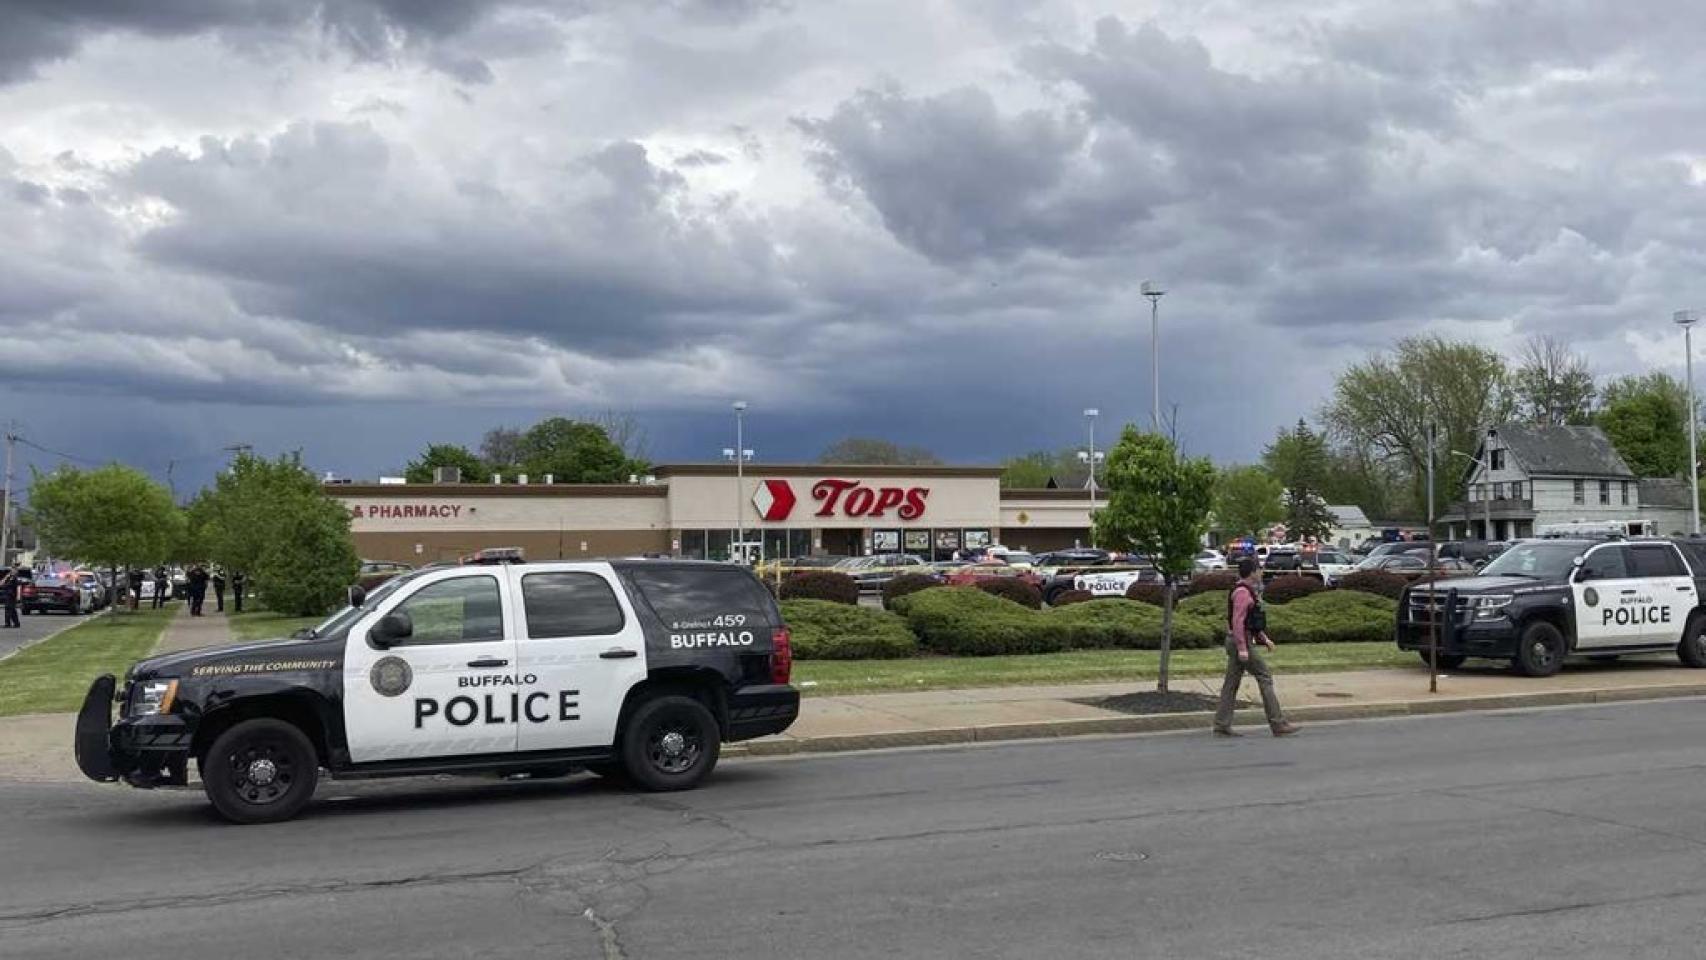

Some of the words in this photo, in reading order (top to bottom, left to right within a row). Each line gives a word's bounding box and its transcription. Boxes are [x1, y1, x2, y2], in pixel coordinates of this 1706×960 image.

[369, 505, 461, 518] PHARMACY
[713, 614, 746, 627] 459
[1602, 606, 1671, 626] POLICE
[670, 631, 754, 648] BUFFALO
[192, 664, 241, 676] SERVING
[243, 663, 265, 673] THE
[266, 660, 336, 671] COMMUNITY
[458, 673, 538, 687] BUFFALO
[414, 689, 580, 729] POLICE
